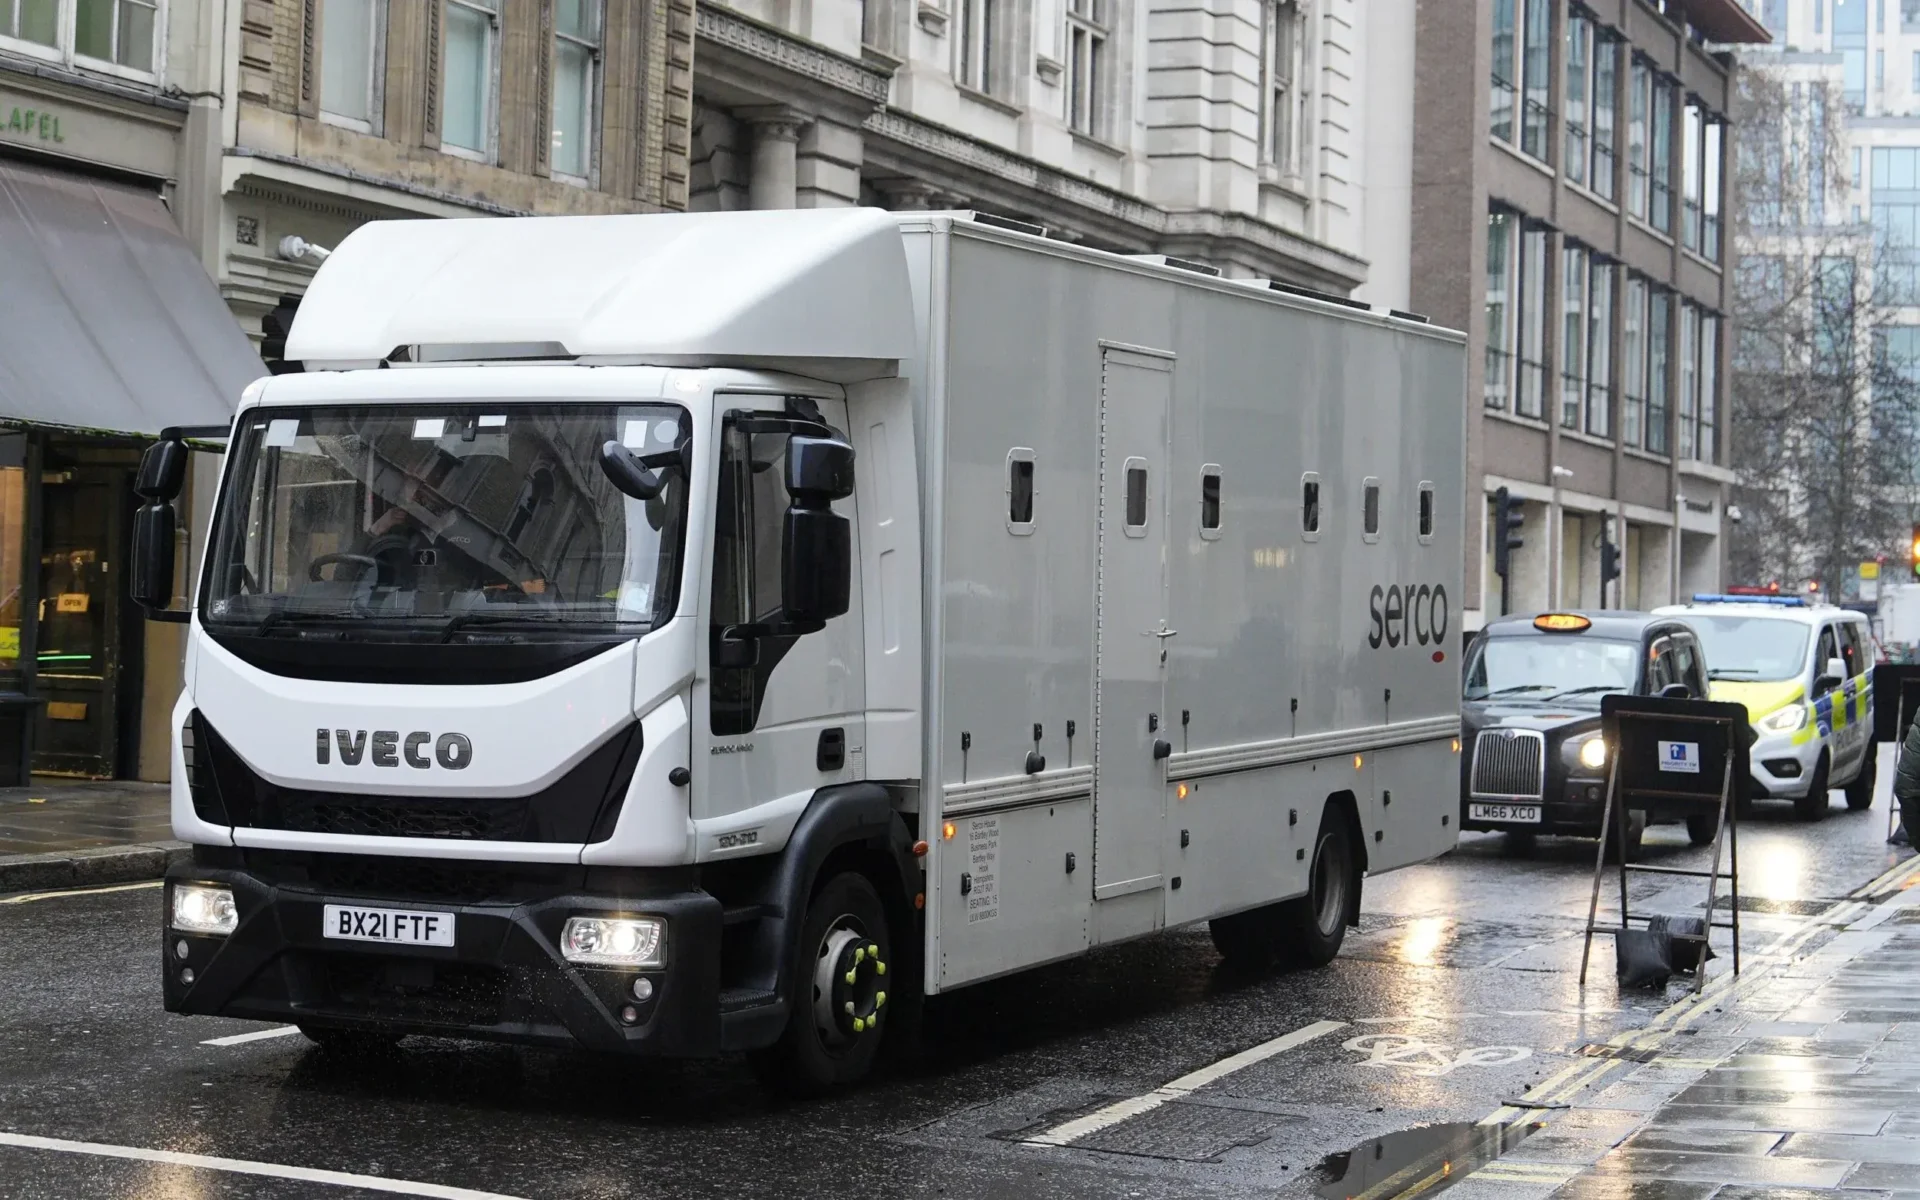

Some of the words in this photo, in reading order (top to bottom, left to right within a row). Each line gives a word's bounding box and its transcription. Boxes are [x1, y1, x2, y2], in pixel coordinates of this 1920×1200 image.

[64, 599, 82, 607] OPEN
[1368, 583, 1448, 650] serco
[316, 728, 473, 770] IVECO
[1475, 805, 1507, 818] LM66
[1510, 807, 1536, 820] XCO
[984, 820, 996, 828] House
[992, 894, 998, 904] 15
[339, 910, 387, 938] BX21
[394, 914, 439, 940] FTF
